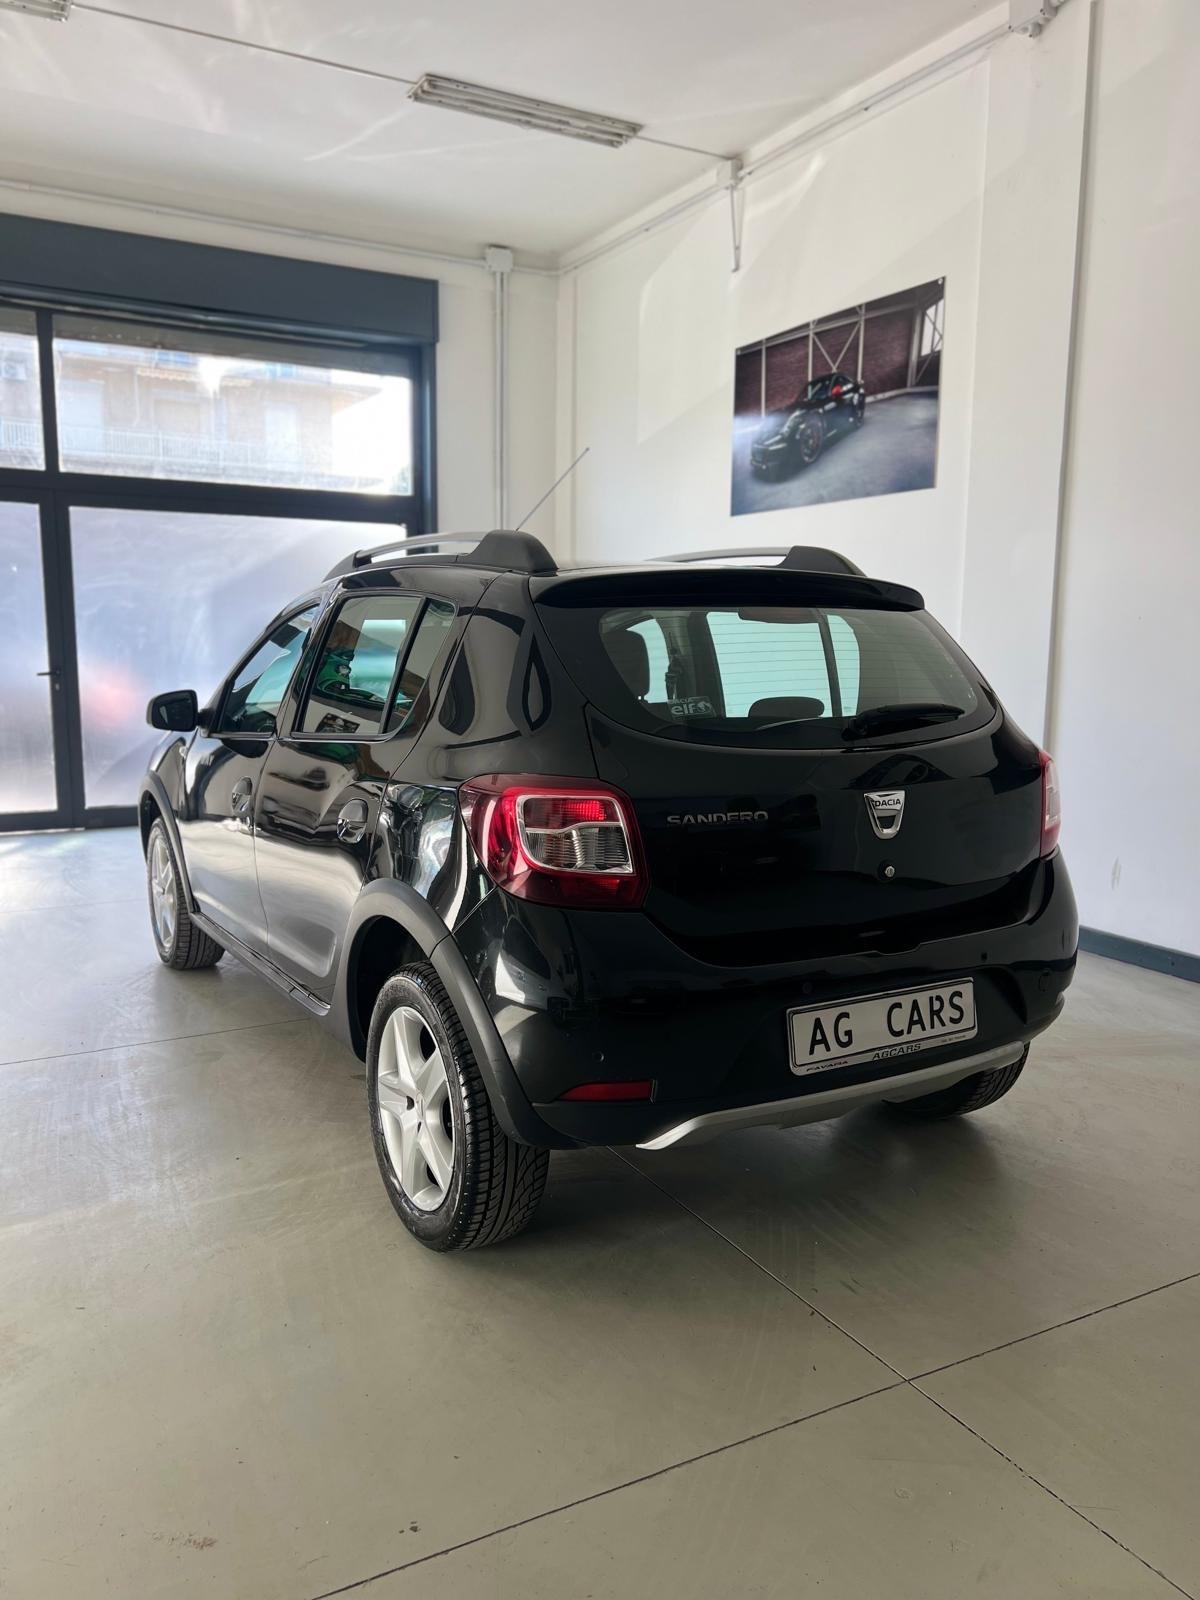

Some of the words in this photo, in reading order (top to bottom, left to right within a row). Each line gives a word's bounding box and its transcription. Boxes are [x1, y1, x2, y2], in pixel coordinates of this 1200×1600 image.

[671, 703, 695, 715] elf
[874, 799, 901, 807] DACIA
[667, 811, 769, 825] SANDERO
[808, 1012, 853, 1056] AG
[887, 990, 965, 1038] CARS
[872, 1043, 921, 1061] AGCARS
